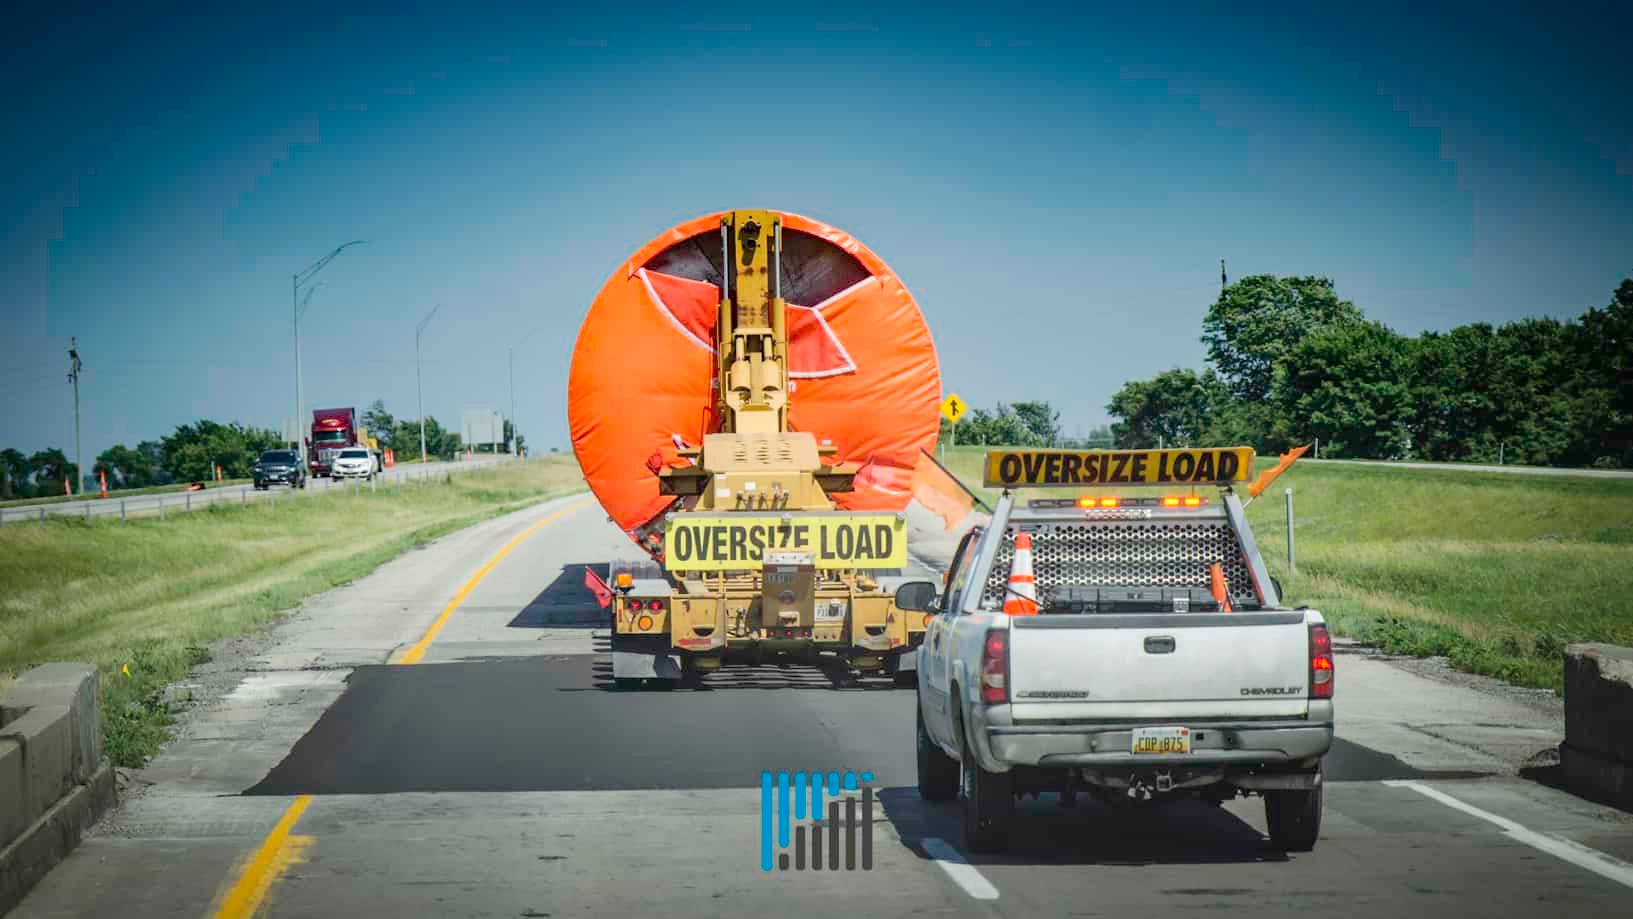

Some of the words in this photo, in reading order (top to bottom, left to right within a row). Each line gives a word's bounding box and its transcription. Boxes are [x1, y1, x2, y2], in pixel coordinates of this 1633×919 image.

[998, 451, 1148, 484] OVERSIZE
[1157, 450, 1240, 482] LOAD
[674, 524, 809, 562] OVERSIZE
[820, 523, 893, 560] LOAD
